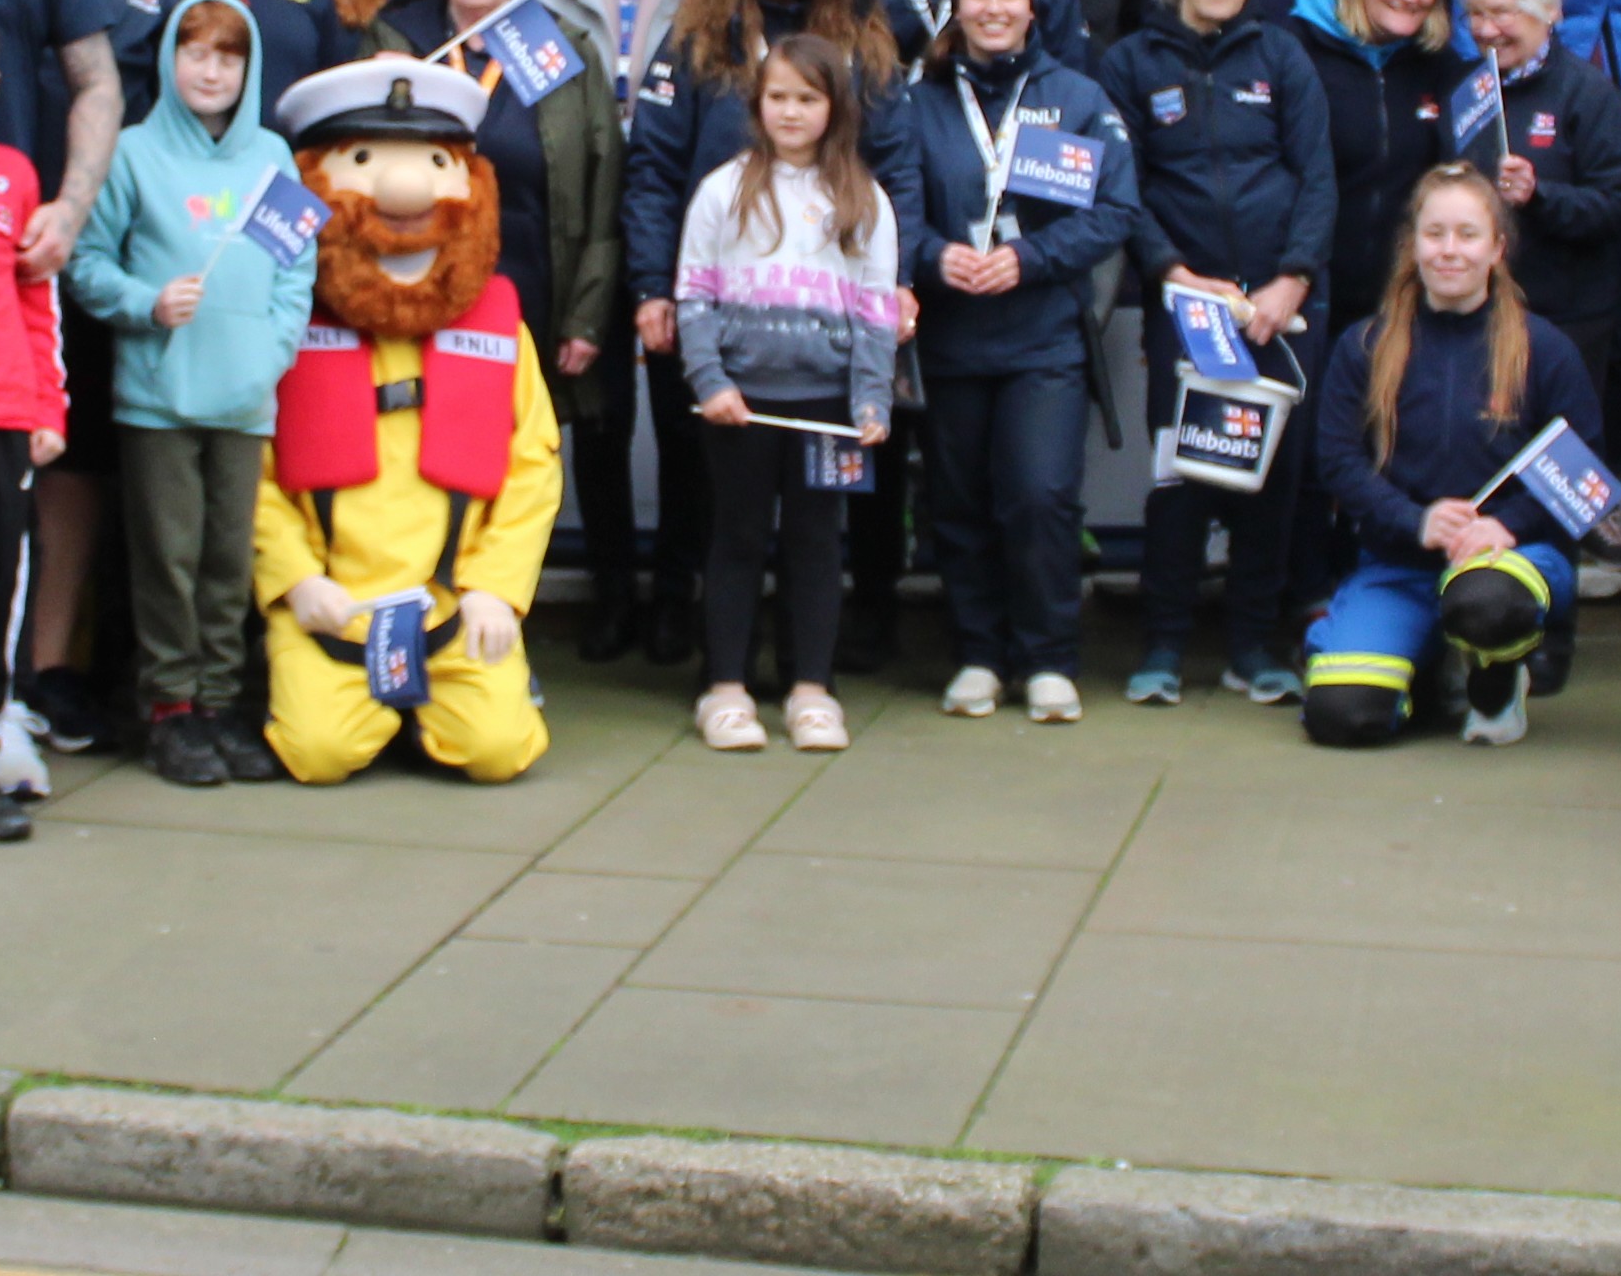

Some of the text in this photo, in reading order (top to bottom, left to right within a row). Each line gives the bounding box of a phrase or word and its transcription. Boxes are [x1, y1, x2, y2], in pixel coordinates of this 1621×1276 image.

[494, 17, 548, 91] Lifeboats
[1017, 106, 1061, 126] RNLI
[1014, 157, 1092, 191] Lifeboats
[454, 335, 501, 356] RNLI
[1180, 424, 1260, 459] Lifeboats
[1535, 454, 1596, 523] Lifeboats
